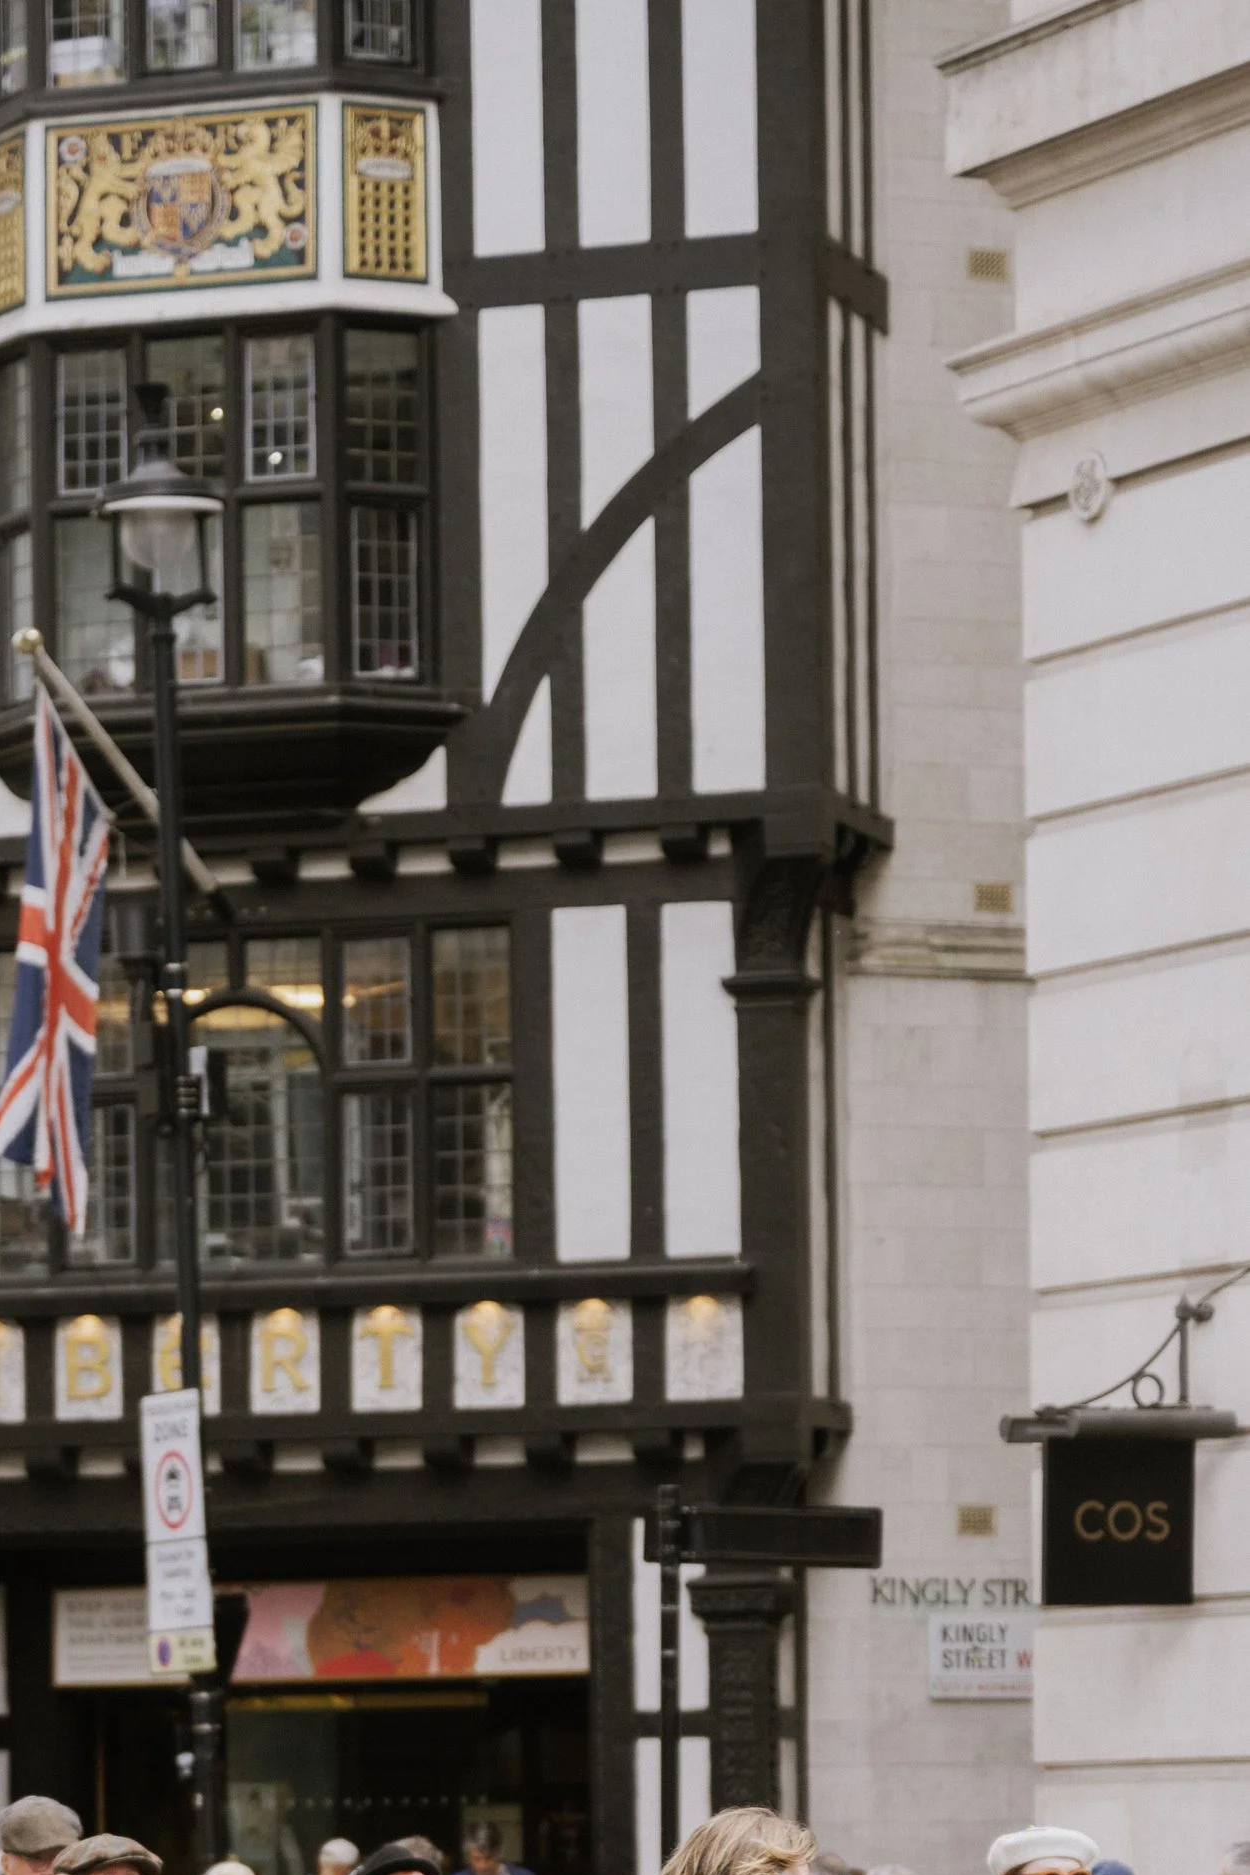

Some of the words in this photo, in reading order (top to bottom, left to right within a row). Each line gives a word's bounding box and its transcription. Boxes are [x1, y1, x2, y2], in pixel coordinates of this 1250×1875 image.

[1074, 1500, 1171, 1541] COS
[869, 1575, 976, 1606] KINGLY
[941, 1623, 1008, 1643] KINGLY
[499, 1645, 581, 1662] LIBERTY
[941, 1648, 1007, 1669] STREET
